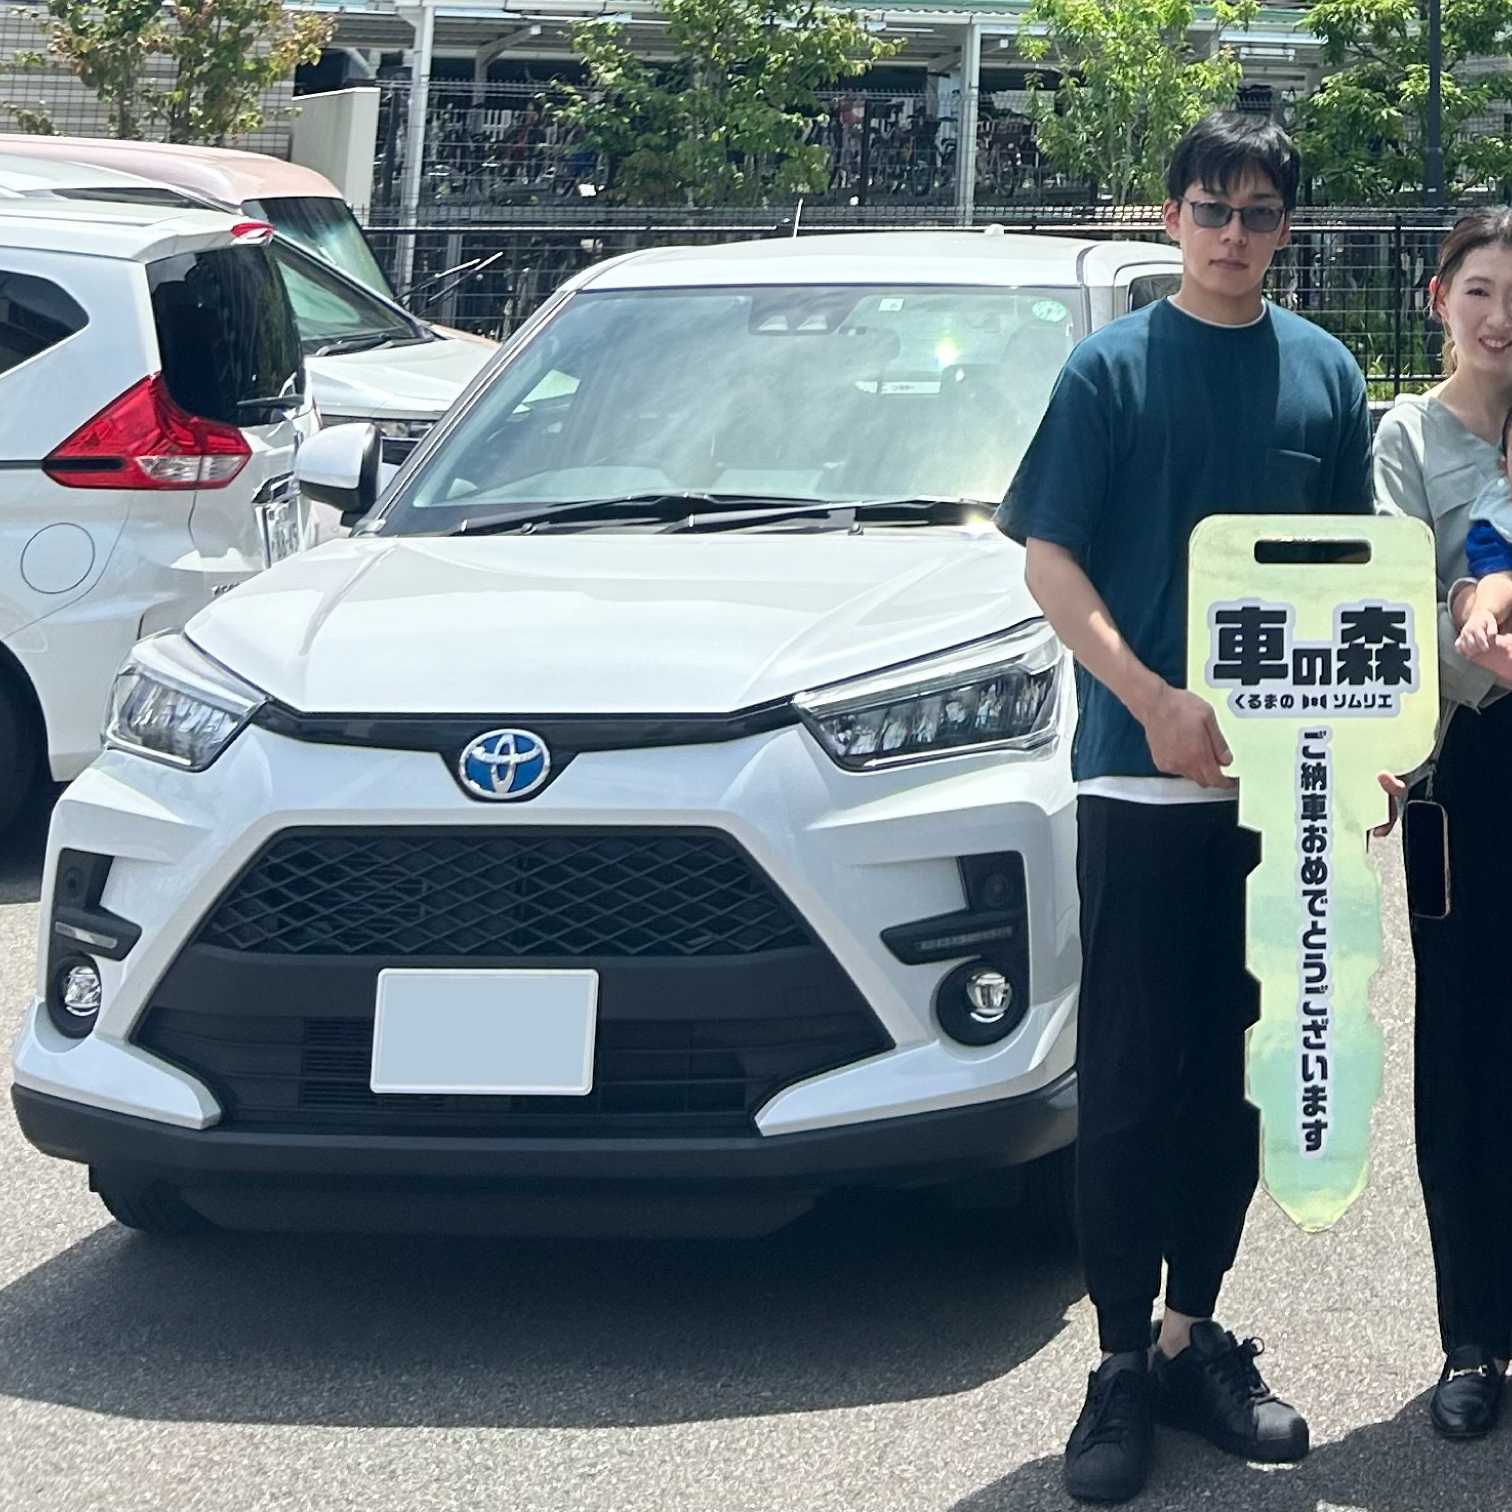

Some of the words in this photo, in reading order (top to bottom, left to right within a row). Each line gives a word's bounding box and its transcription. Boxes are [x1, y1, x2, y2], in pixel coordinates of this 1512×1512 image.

[1212, 606, 1412, 686] 車の森
[1234, 693, 1294, 710] くるまの
[1333, 693, 1393, 710] ソムリエ
[1300, 730, 1330, 1152] ご納車おめでとうございます
